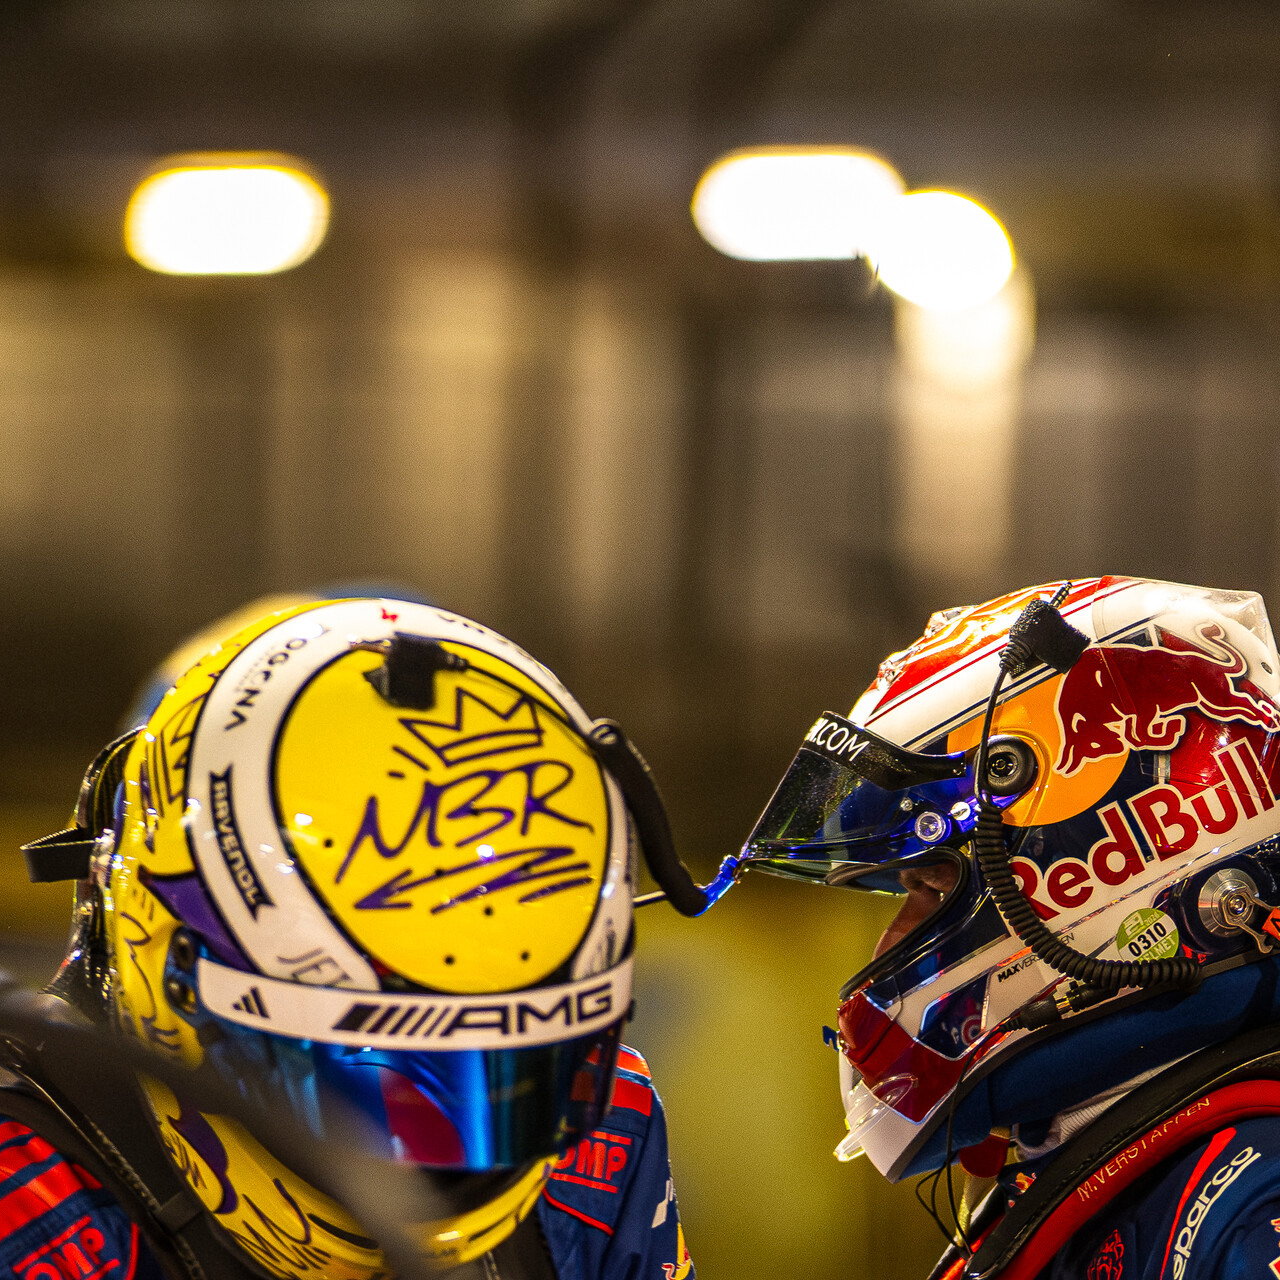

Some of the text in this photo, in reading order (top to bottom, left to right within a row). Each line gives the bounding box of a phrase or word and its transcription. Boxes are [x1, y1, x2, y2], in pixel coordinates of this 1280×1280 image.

[212, 780, 260, 906] RAVENOL
[1007, 738, 1277, 923] Red Bull
[1128, 922, 1167, 957] 0310
